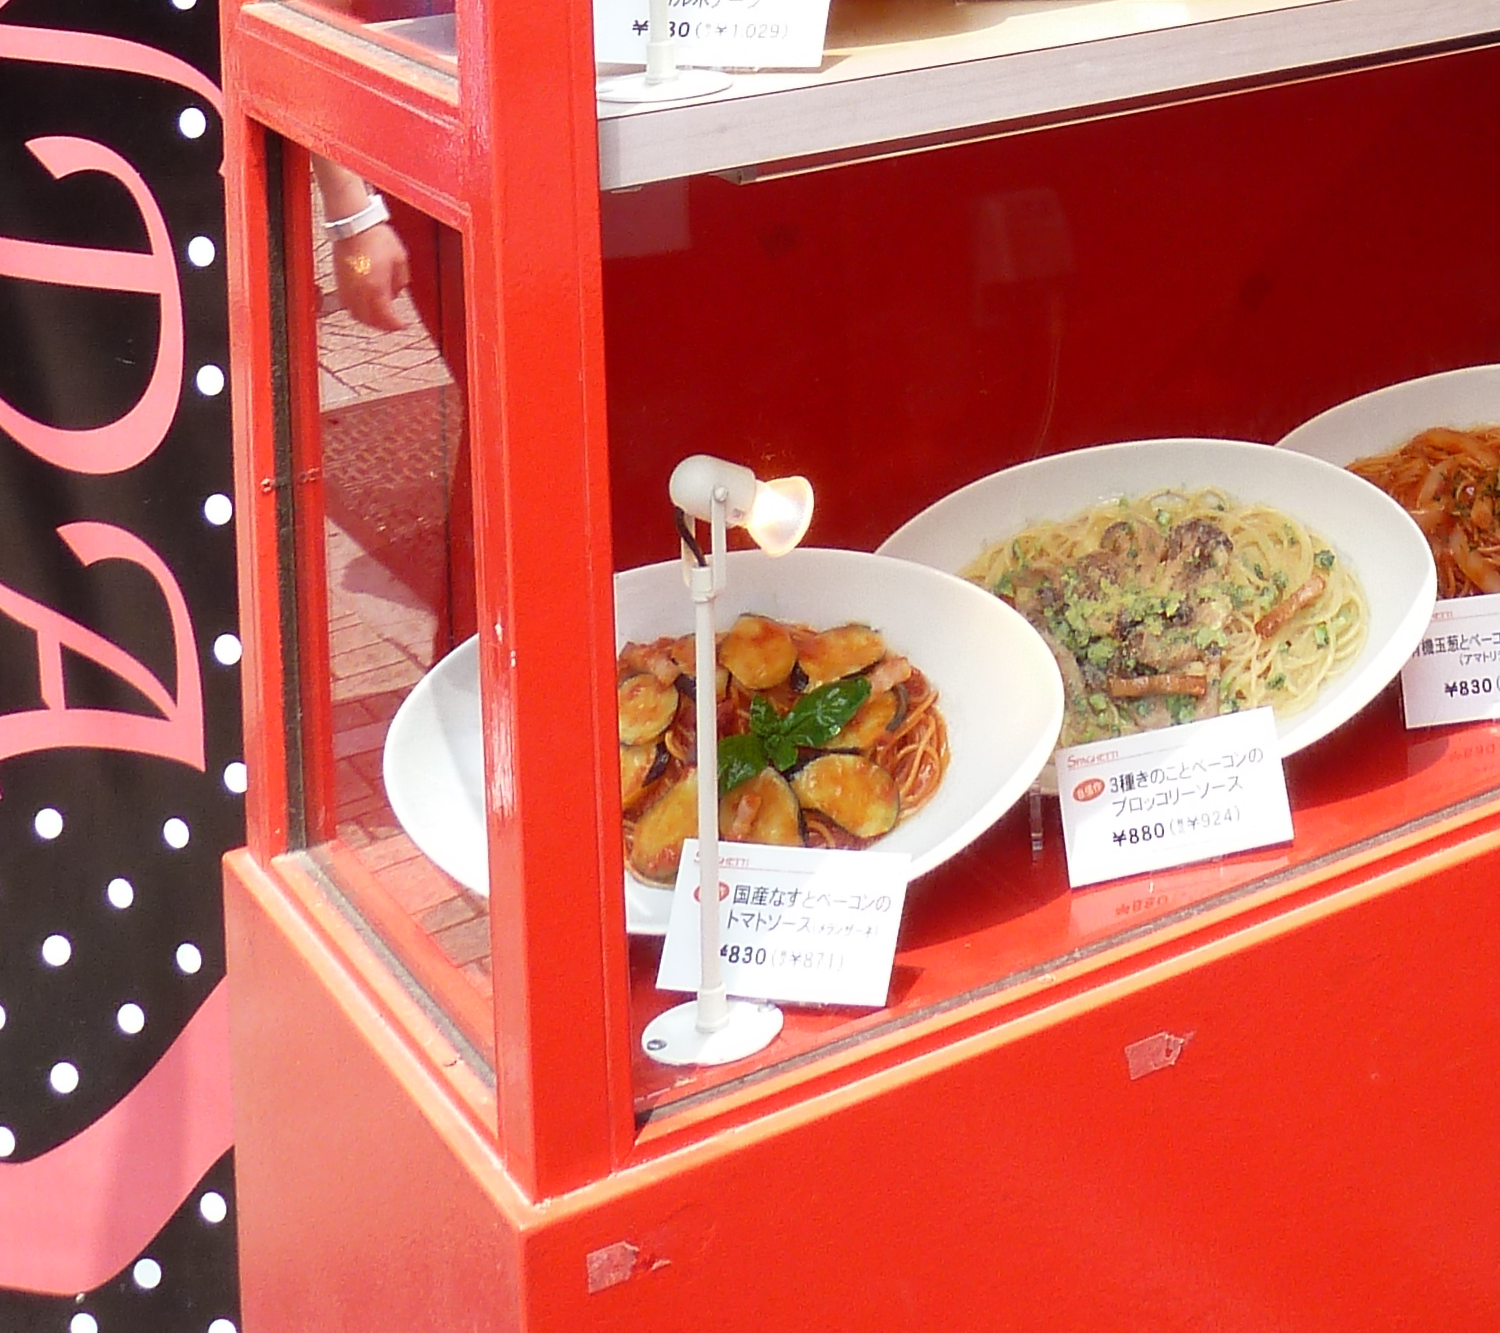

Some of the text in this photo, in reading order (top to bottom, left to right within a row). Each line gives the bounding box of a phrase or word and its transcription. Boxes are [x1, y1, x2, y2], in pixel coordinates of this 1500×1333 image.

[632, 19, 690, 38] ¥30
[1444, 678, 1493, 698] ¥830
[1112, 775, 1244, 818] ブロッコリーソース
[1112, 822, 1166, 847] ¥880
[733, 884, 892, 913] 国産なすとベーコンの
